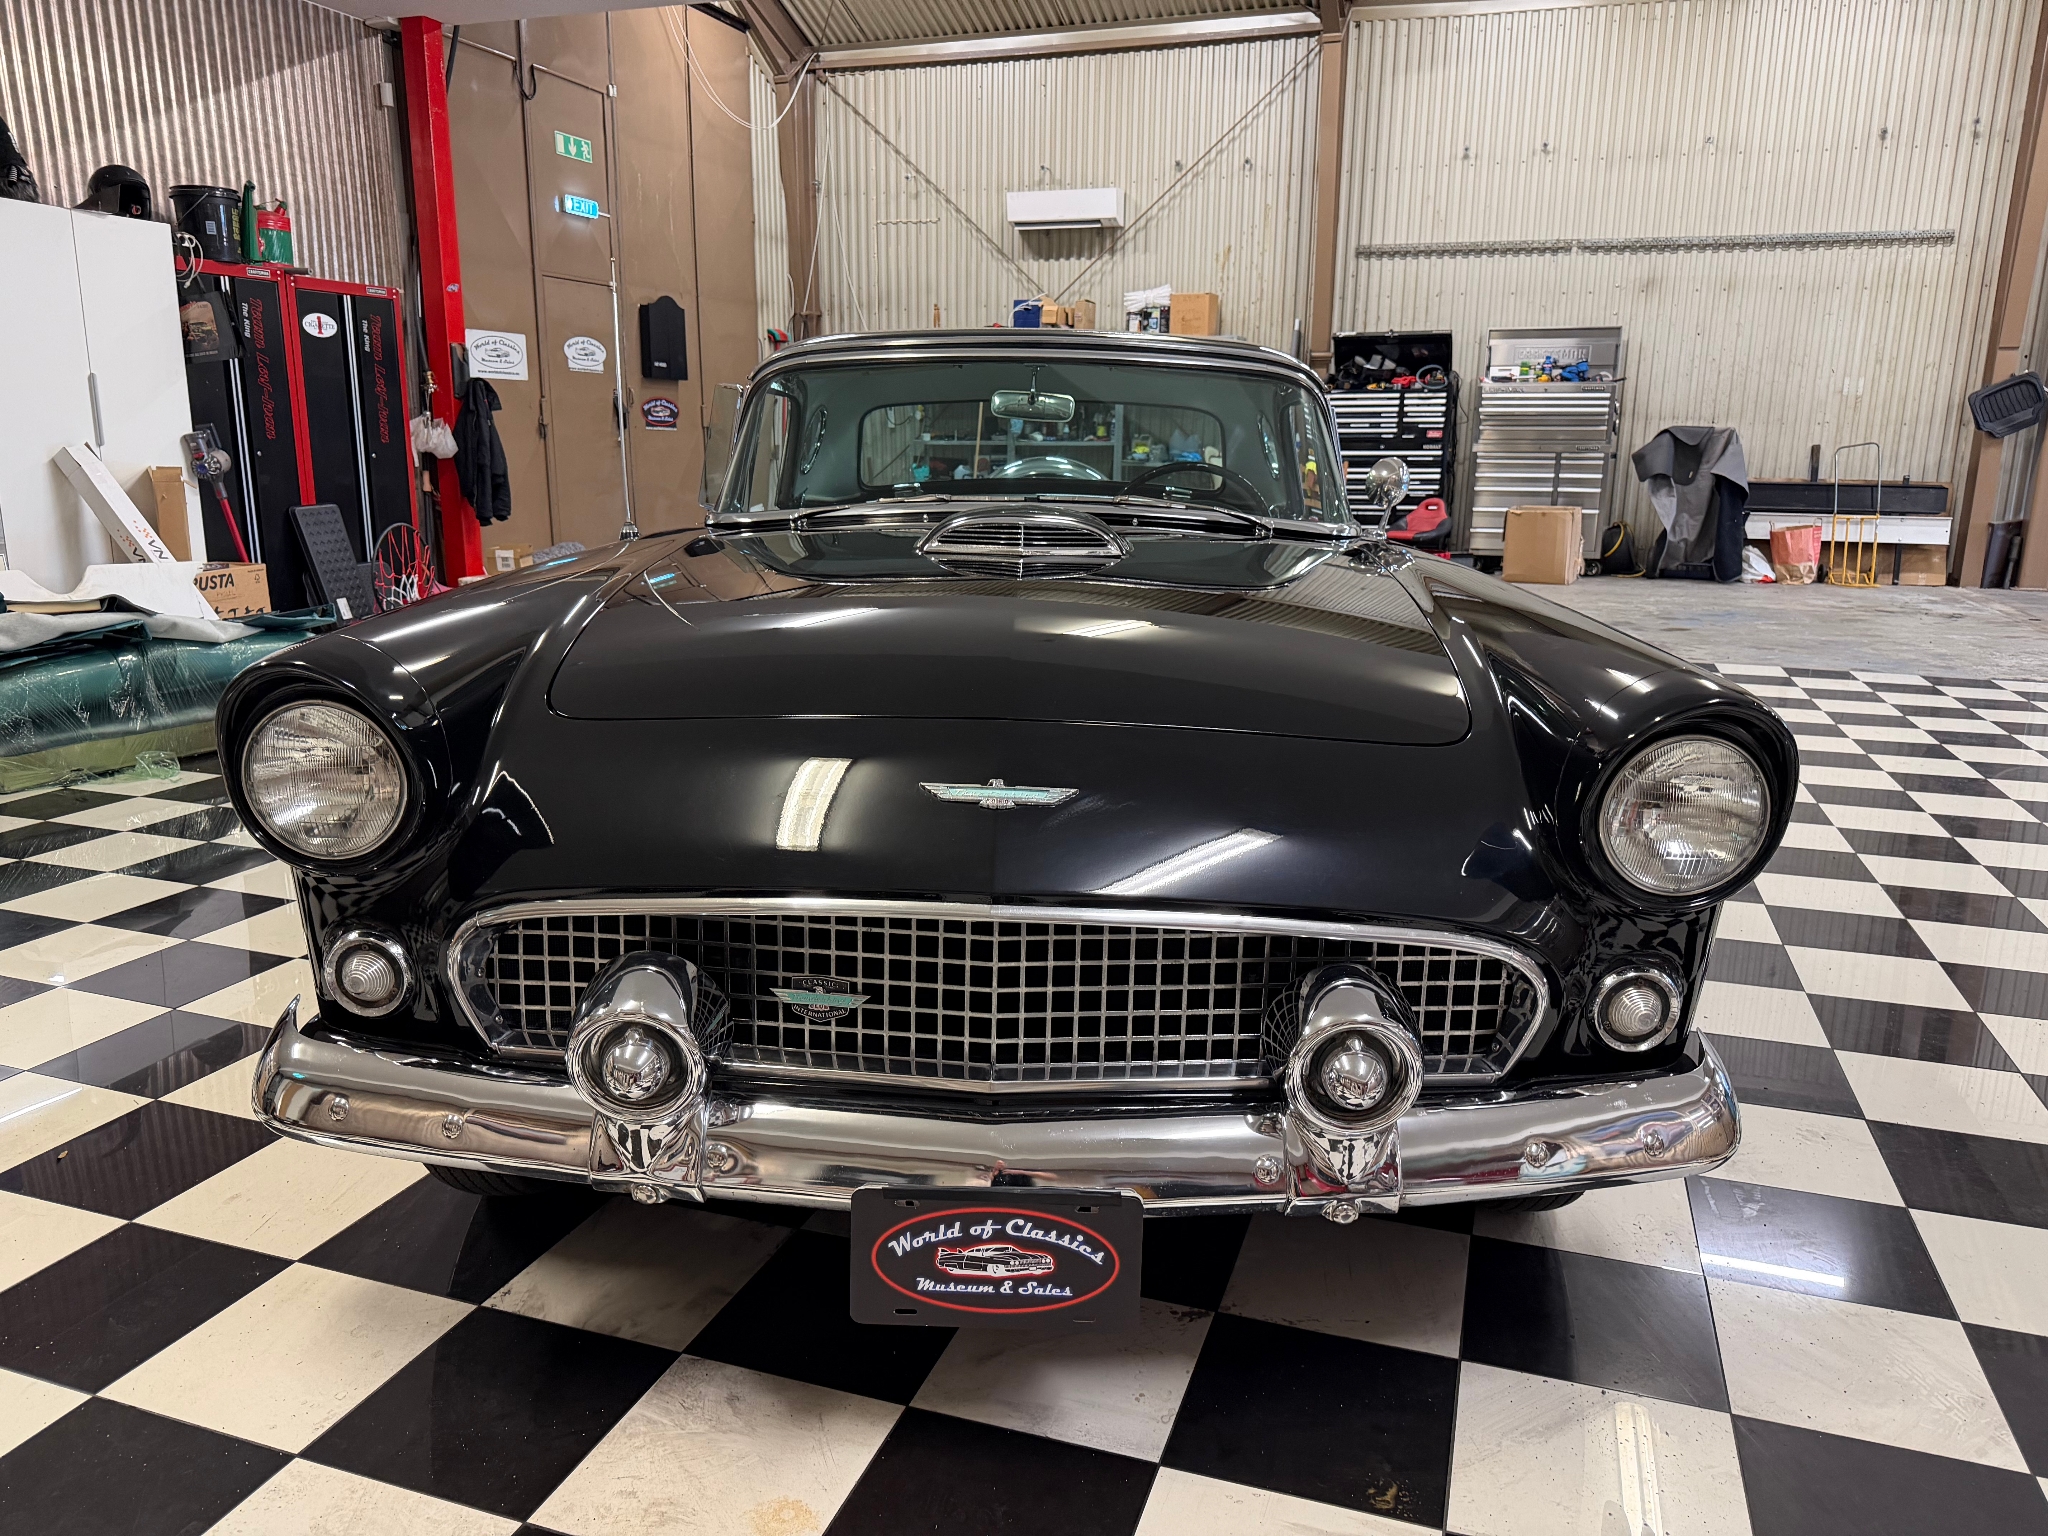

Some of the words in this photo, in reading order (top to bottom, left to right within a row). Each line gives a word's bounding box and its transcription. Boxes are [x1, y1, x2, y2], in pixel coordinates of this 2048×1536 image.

[574, 201, 594, 215] EXIT
[250, 298, 266, 349] Team
[474, 340, 490, 351] World
[498, 339, 520, 355] Classics
[802, 979, 840, 989] CLASSIC
[793, 1004, 847, 1018] INTERNATIONAL
[888, 1220, 963, 1257] World
[969, 1219, 1001, 1240] of
[1006, 1218, 1106, 1265] Classics
[916, 1277, 995, 1295] Museum
[999, 1280, 1014, 1295] &
[1018, 1280, 1073, 1297] Sales
